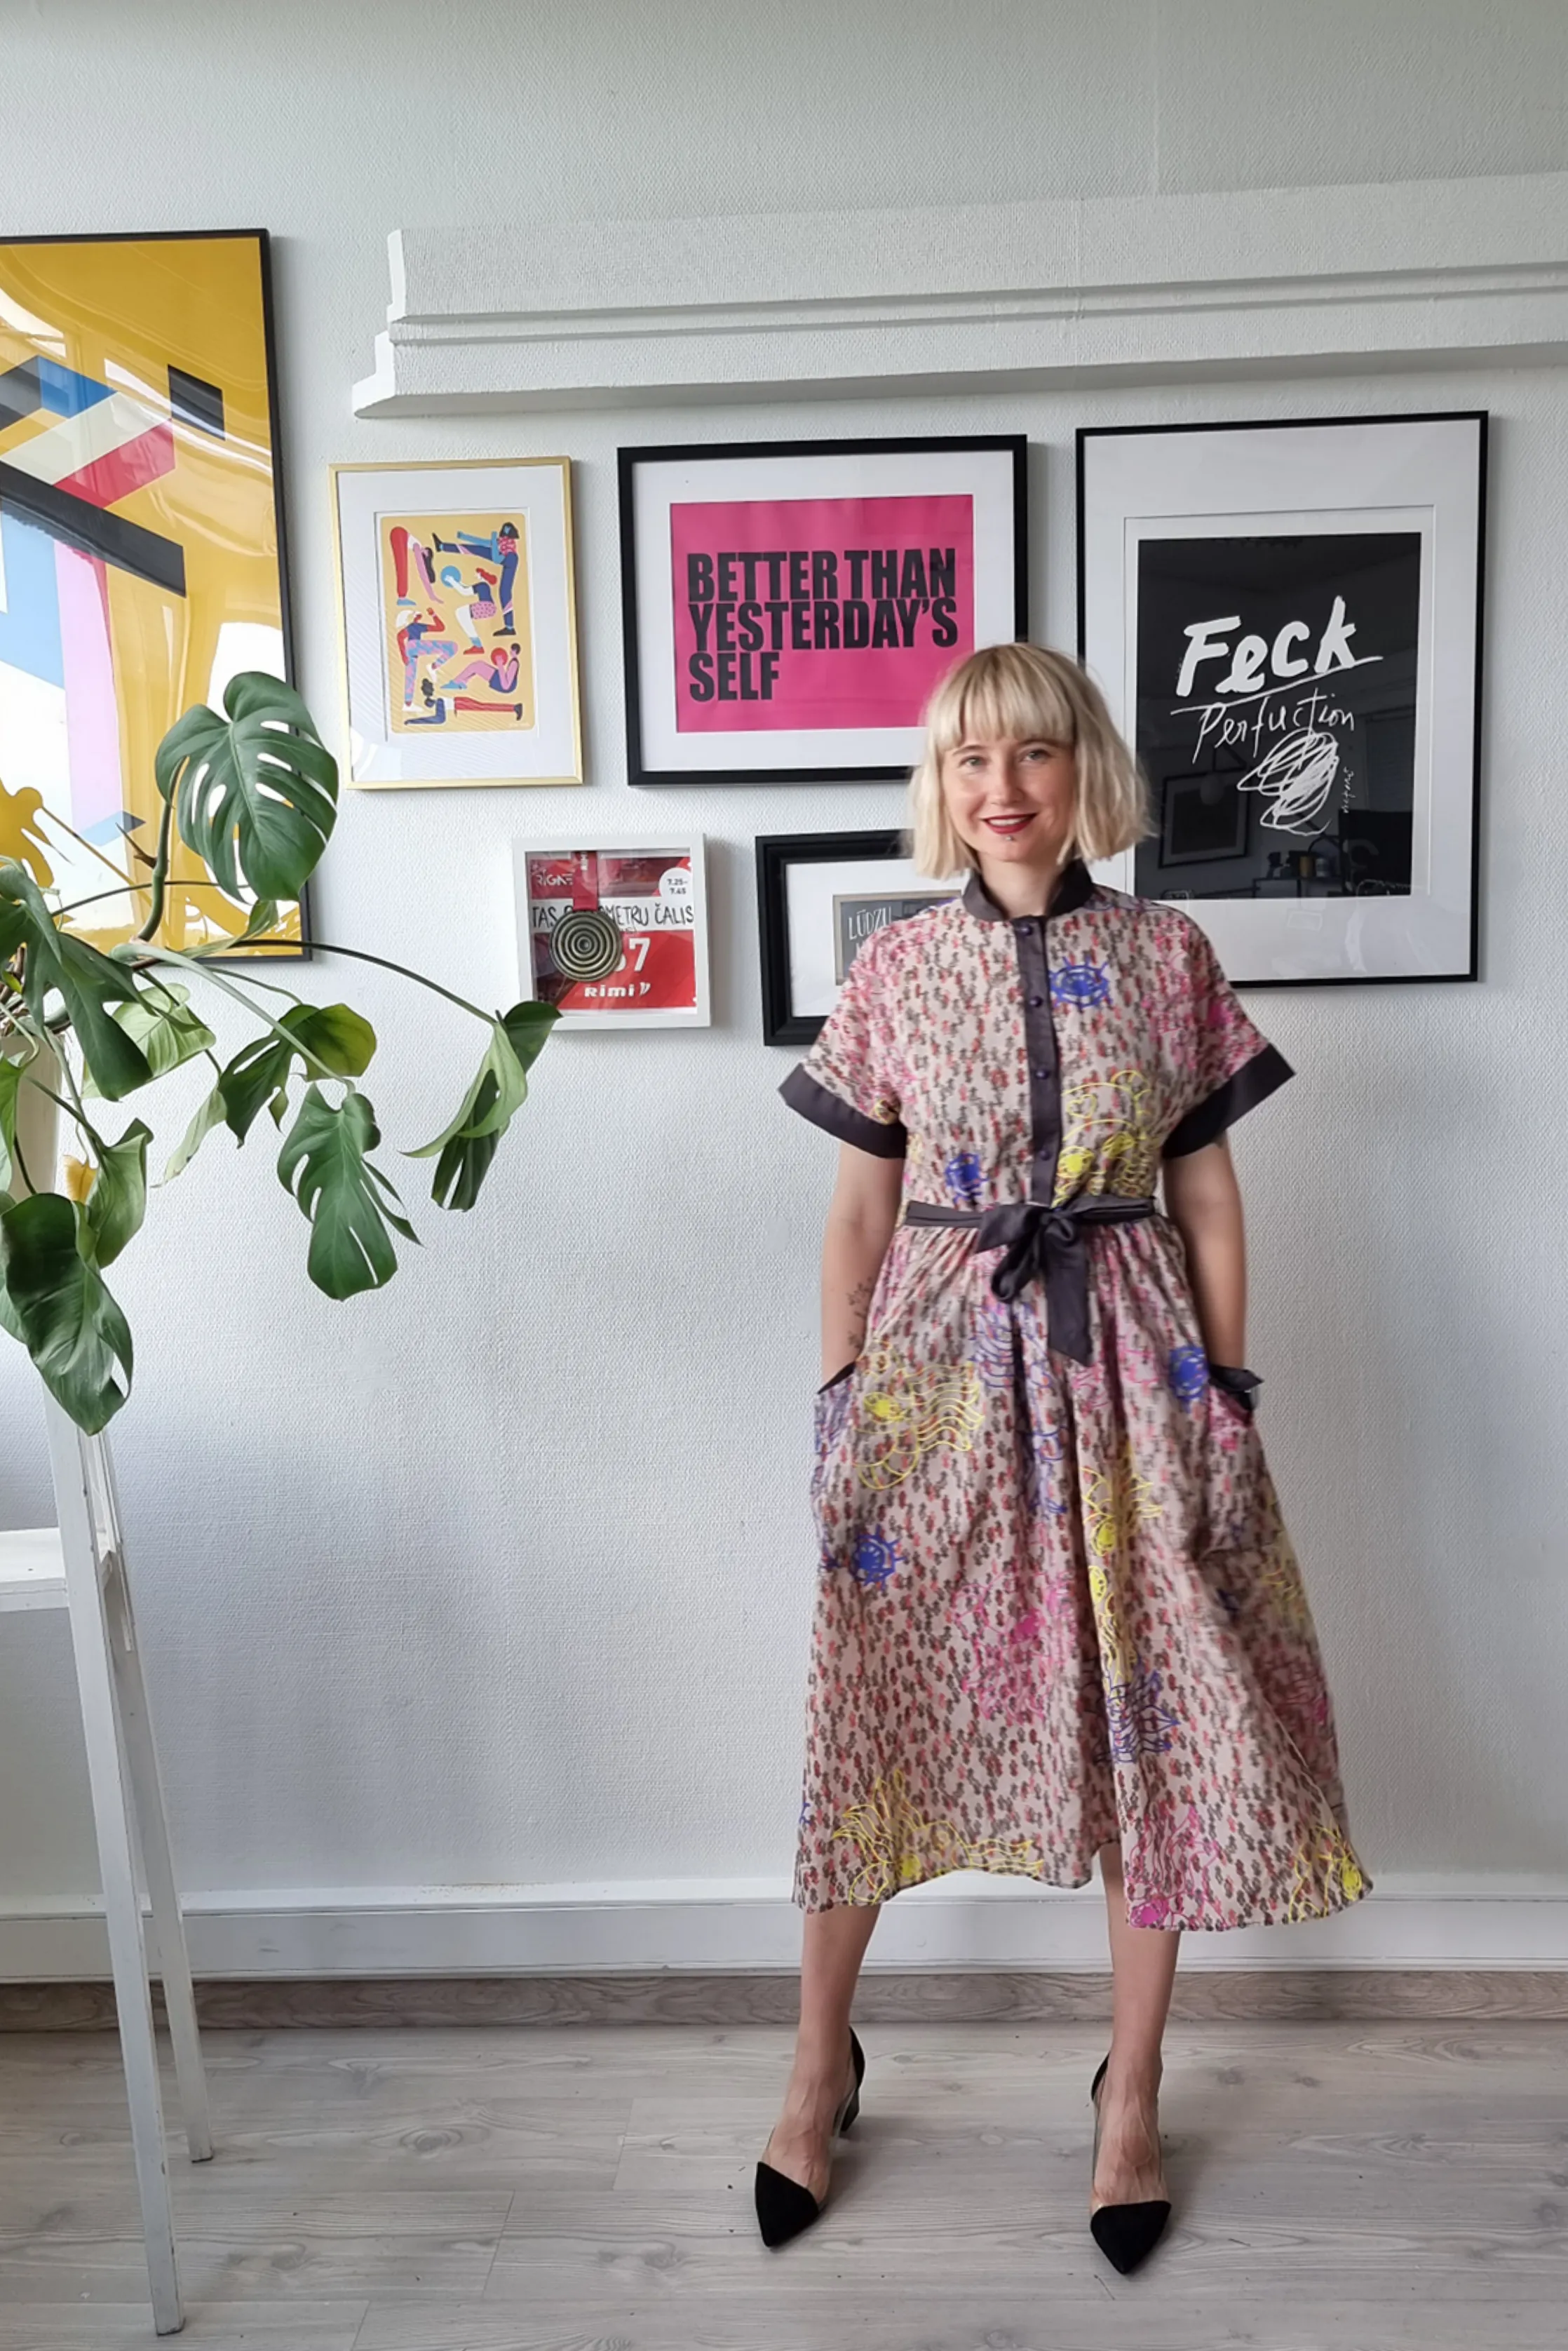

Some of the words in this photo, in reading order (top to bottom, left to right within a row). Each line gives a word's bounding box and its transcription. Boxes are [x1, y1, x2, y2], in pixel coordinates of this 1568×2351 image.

[687, 551, 838, 602] BETTER
[844, 548, 955, 600] THAN
[688, 597, 958, 651] YESTERDAY'S
[689, 652, 780, 701] SELF
[654, 902, 694, 925] ČALIS
